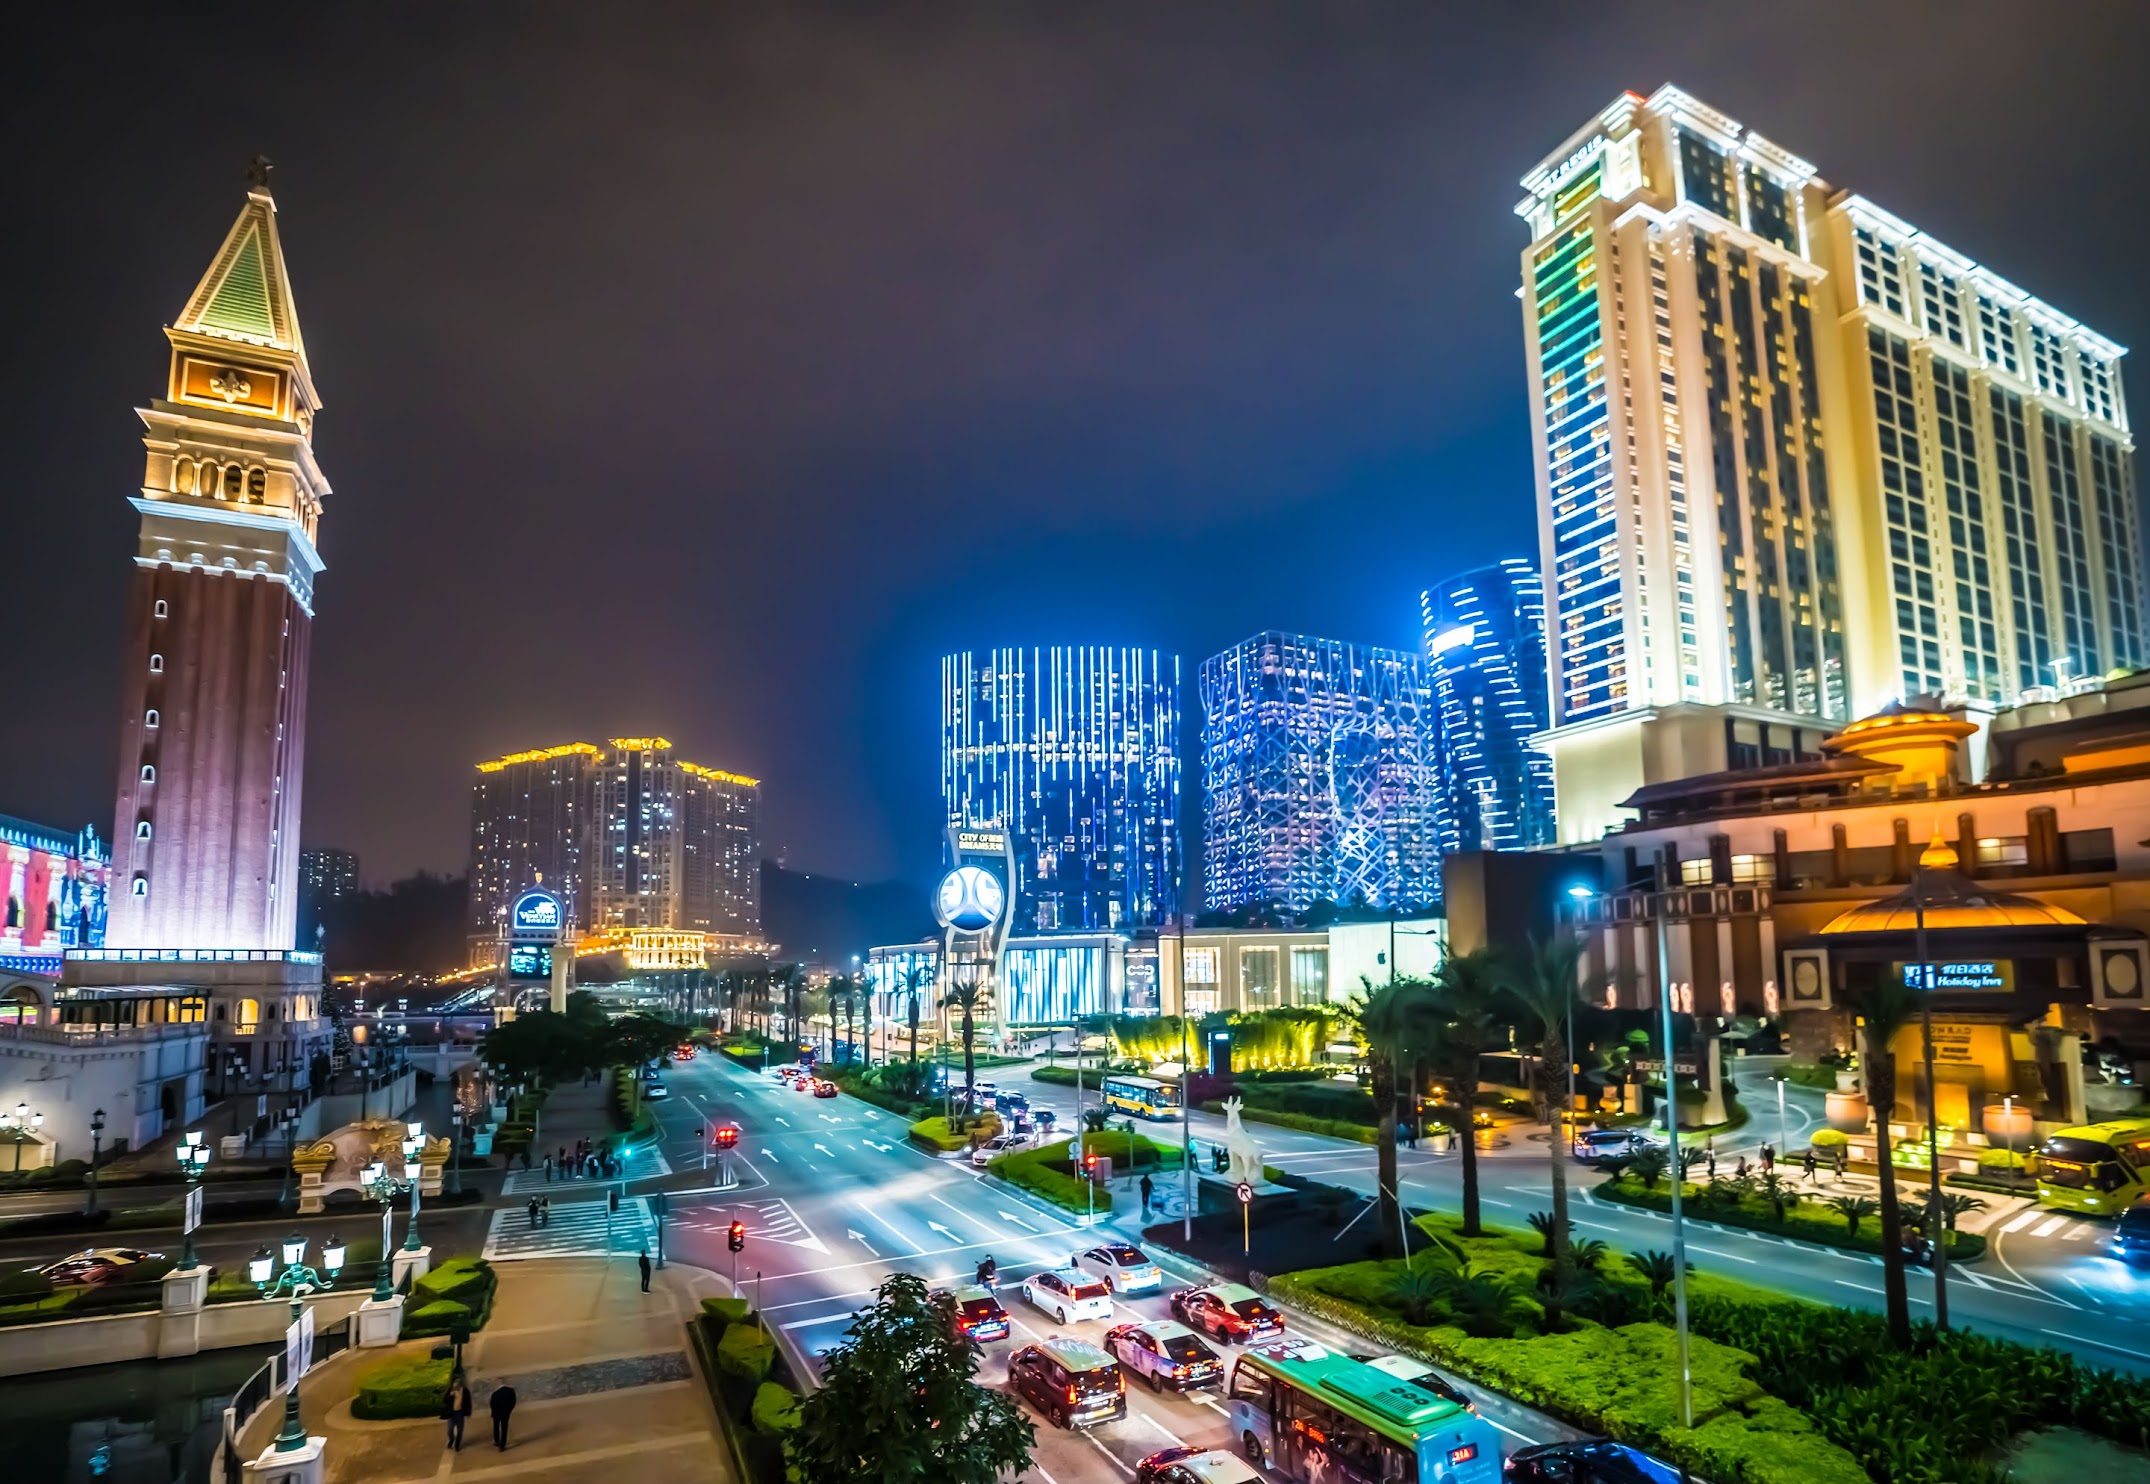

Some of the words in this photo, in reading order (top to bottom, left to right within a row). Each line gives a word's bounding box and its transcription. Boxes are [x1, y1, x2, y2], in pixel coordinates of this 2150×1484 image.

[959, 833, 979, 842] CITY
[959, 841, 988, 850] DREAMS
[1937, 976, 1982, 988] Holiday
[1982, 976, 2003, 986] Inn
